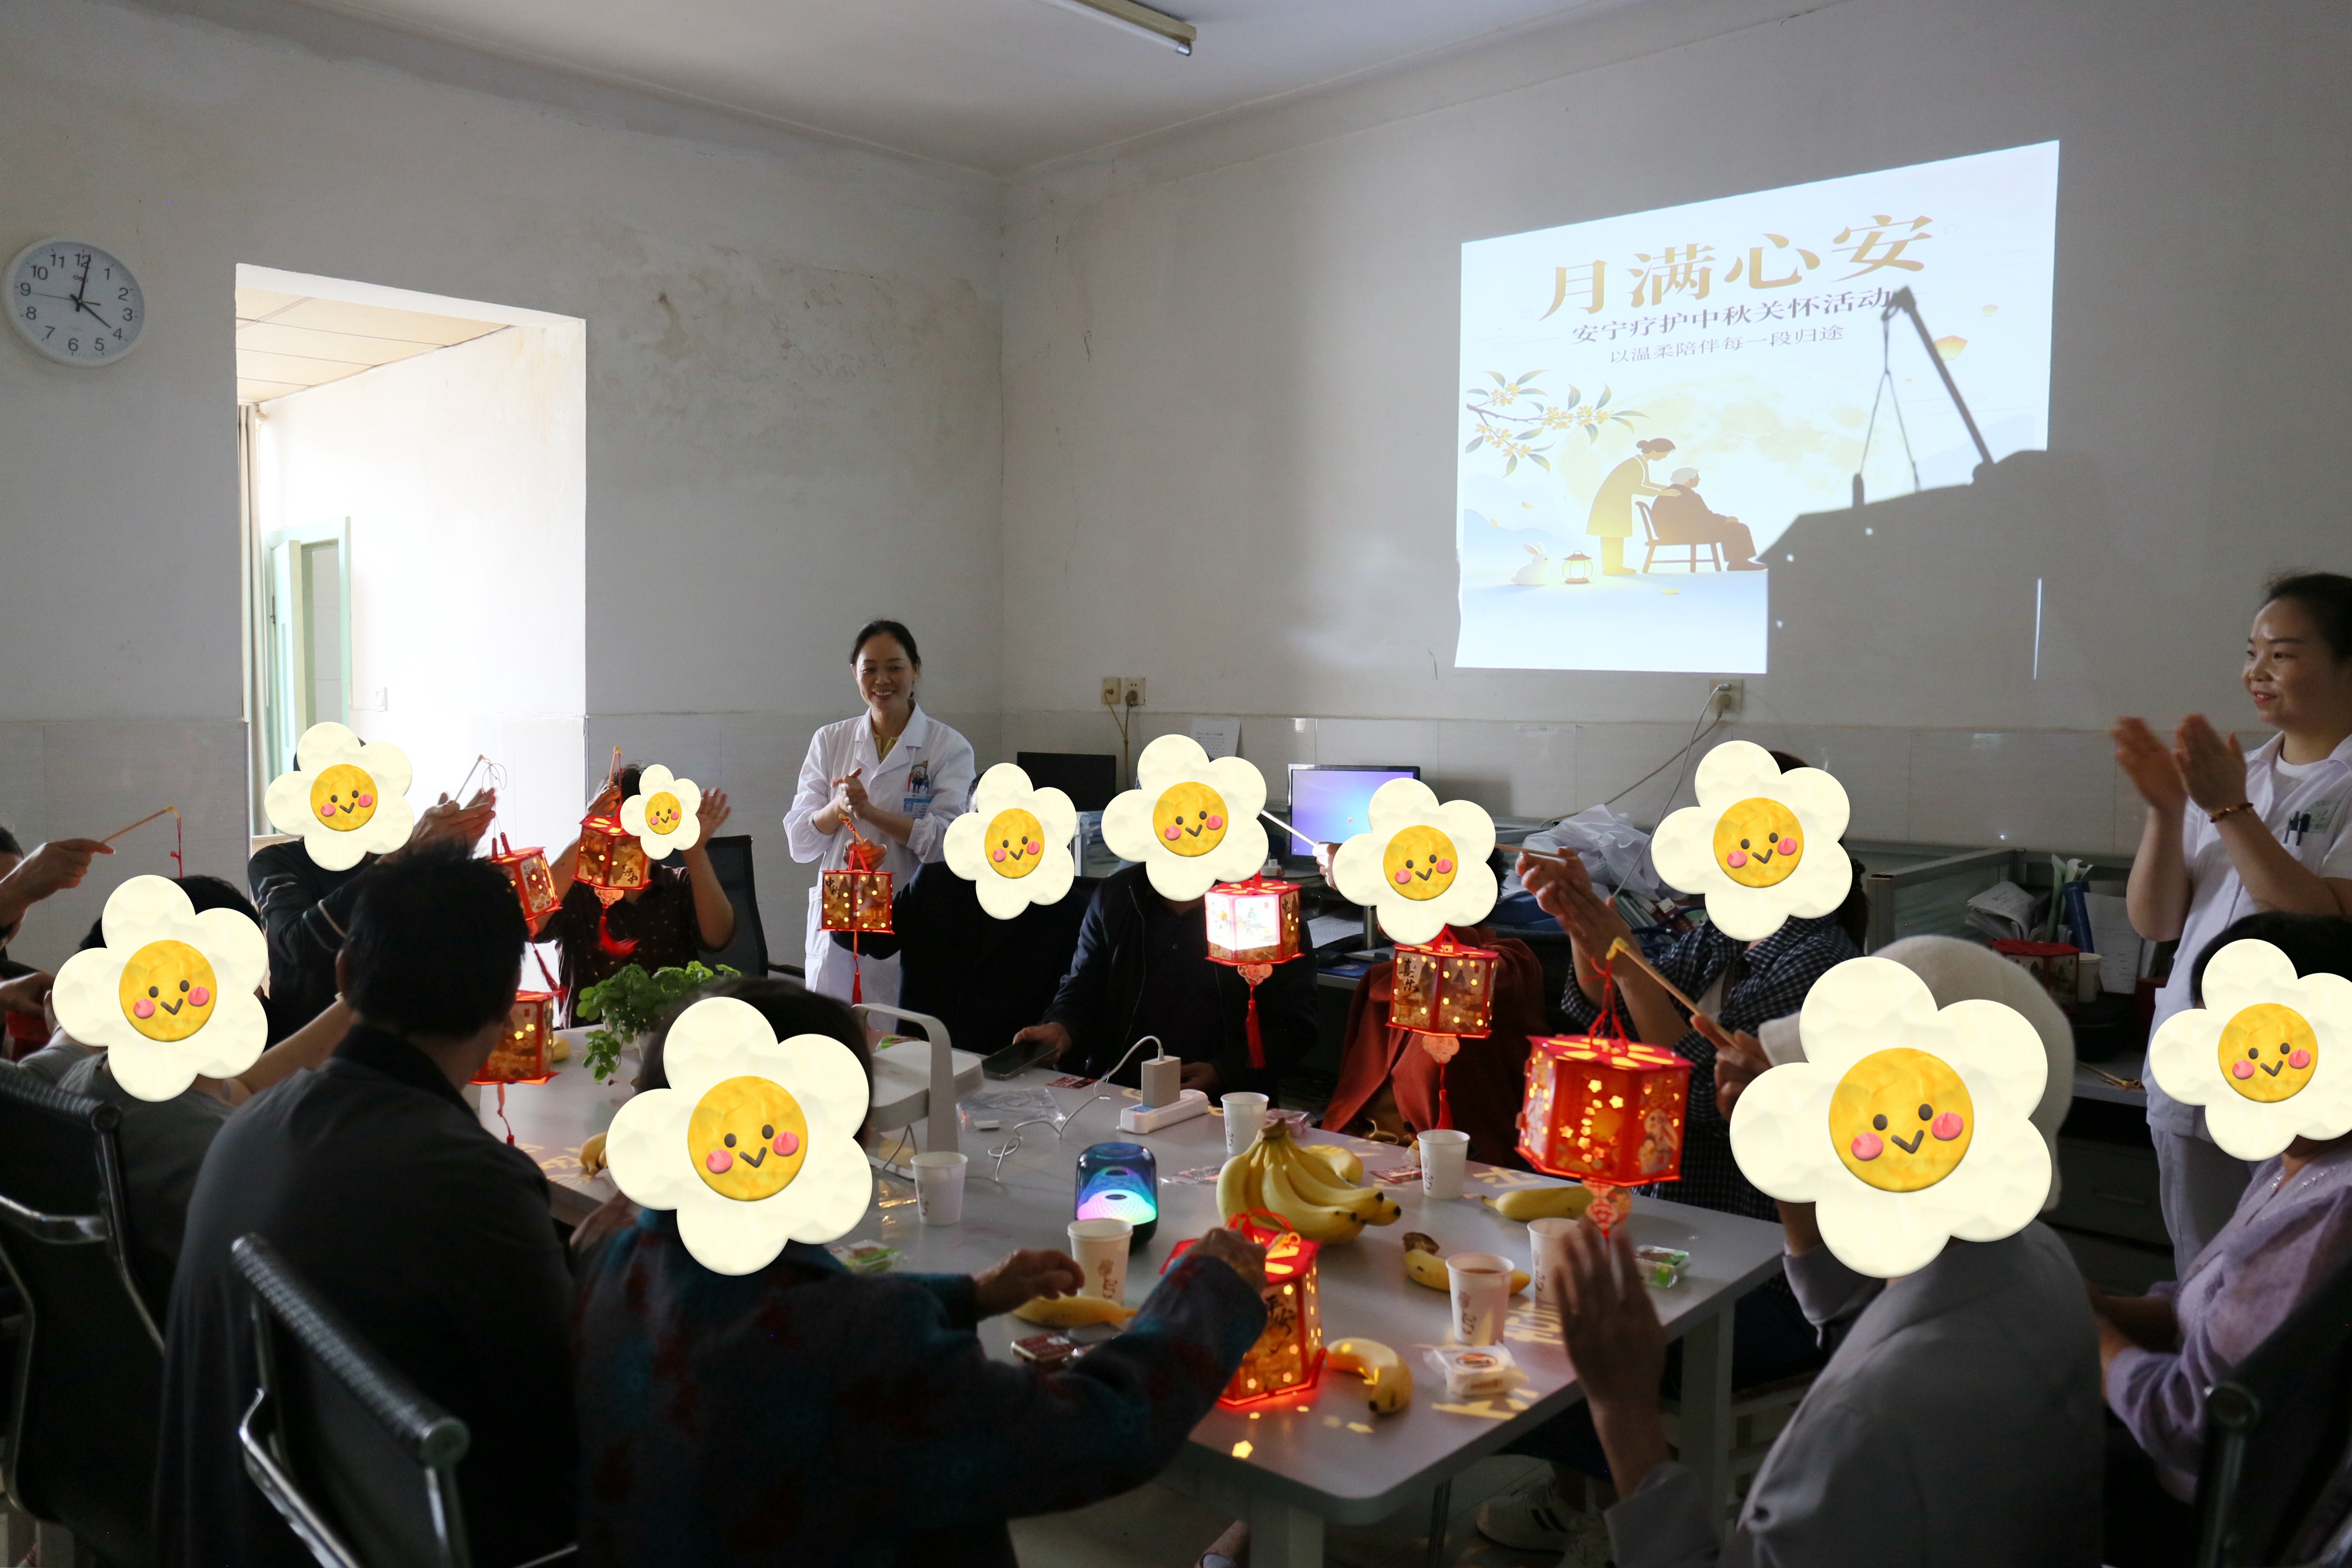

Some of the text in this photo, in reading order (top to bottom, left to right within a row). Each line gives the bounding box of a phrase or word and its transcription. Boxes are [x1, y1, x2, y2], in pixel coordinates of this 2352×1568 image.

[50, 254, 65, 268] 11
[75, 253, 91, 269] 12
[1538, 214, 1933, 322] 月满心安
[31, 265, 48, 280] 10
[104, 267, 110, 280] 1
[20, 282, 31, 296] 9
[118, 287, 129, 301] 2
[26, 306, 36, 320] 8
[123, 308, 133, 321] 3
[1572, 287, 1891, 345] 安宁疗护中秋关怀活动
[45, 326, 56, 339] 7
[113, 327, 123, 340] 4
[68, 338, 79, 351] 6
[94, 338, 105, 351] 5
[1611, 325, 1844, 363] 以温柔陪伴每一段归途
[825, 876, 841, 899] 中秋
